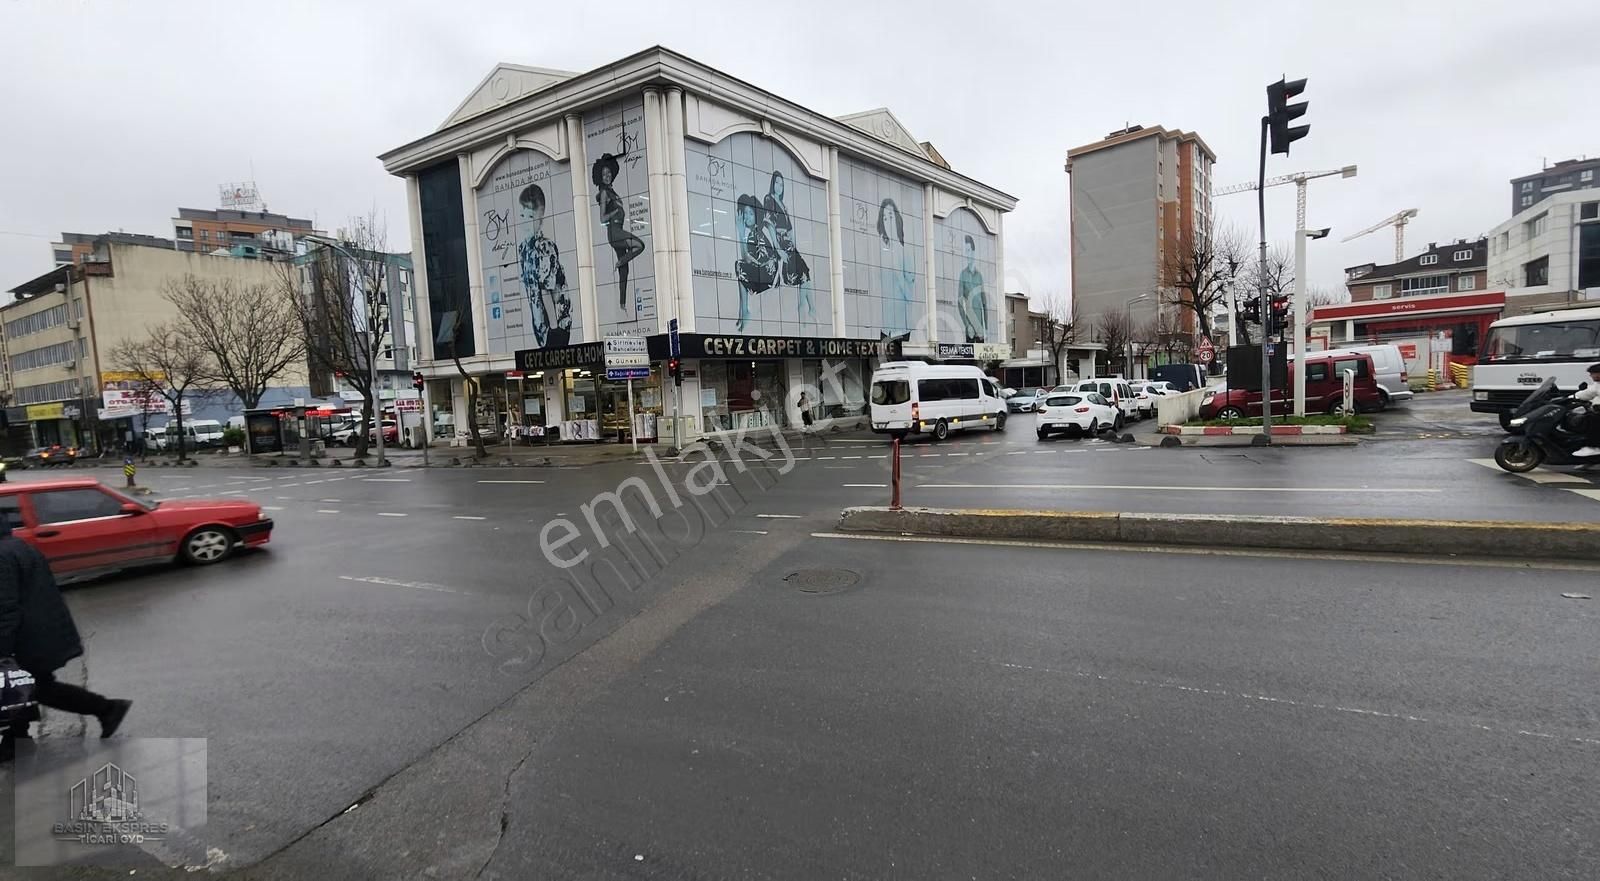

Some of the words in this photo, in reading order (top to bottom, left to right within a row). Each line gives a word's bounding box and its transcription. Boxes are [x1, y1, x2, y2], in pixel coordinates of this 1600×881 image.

[524, 351, 543, 369] CEYZ
[545, 349, 575, 366] CARPET
[576, 347, 583, 363] &
[584, 345, 604, 362] HOM
[704, 338, 744, 355] CEYZ
[748, 339, 800, 356] CARPET
[806, 340, 815, 355] &
[820, 340, 852, 356] HOME
[855, 341, 895, 356] TEXTILE
